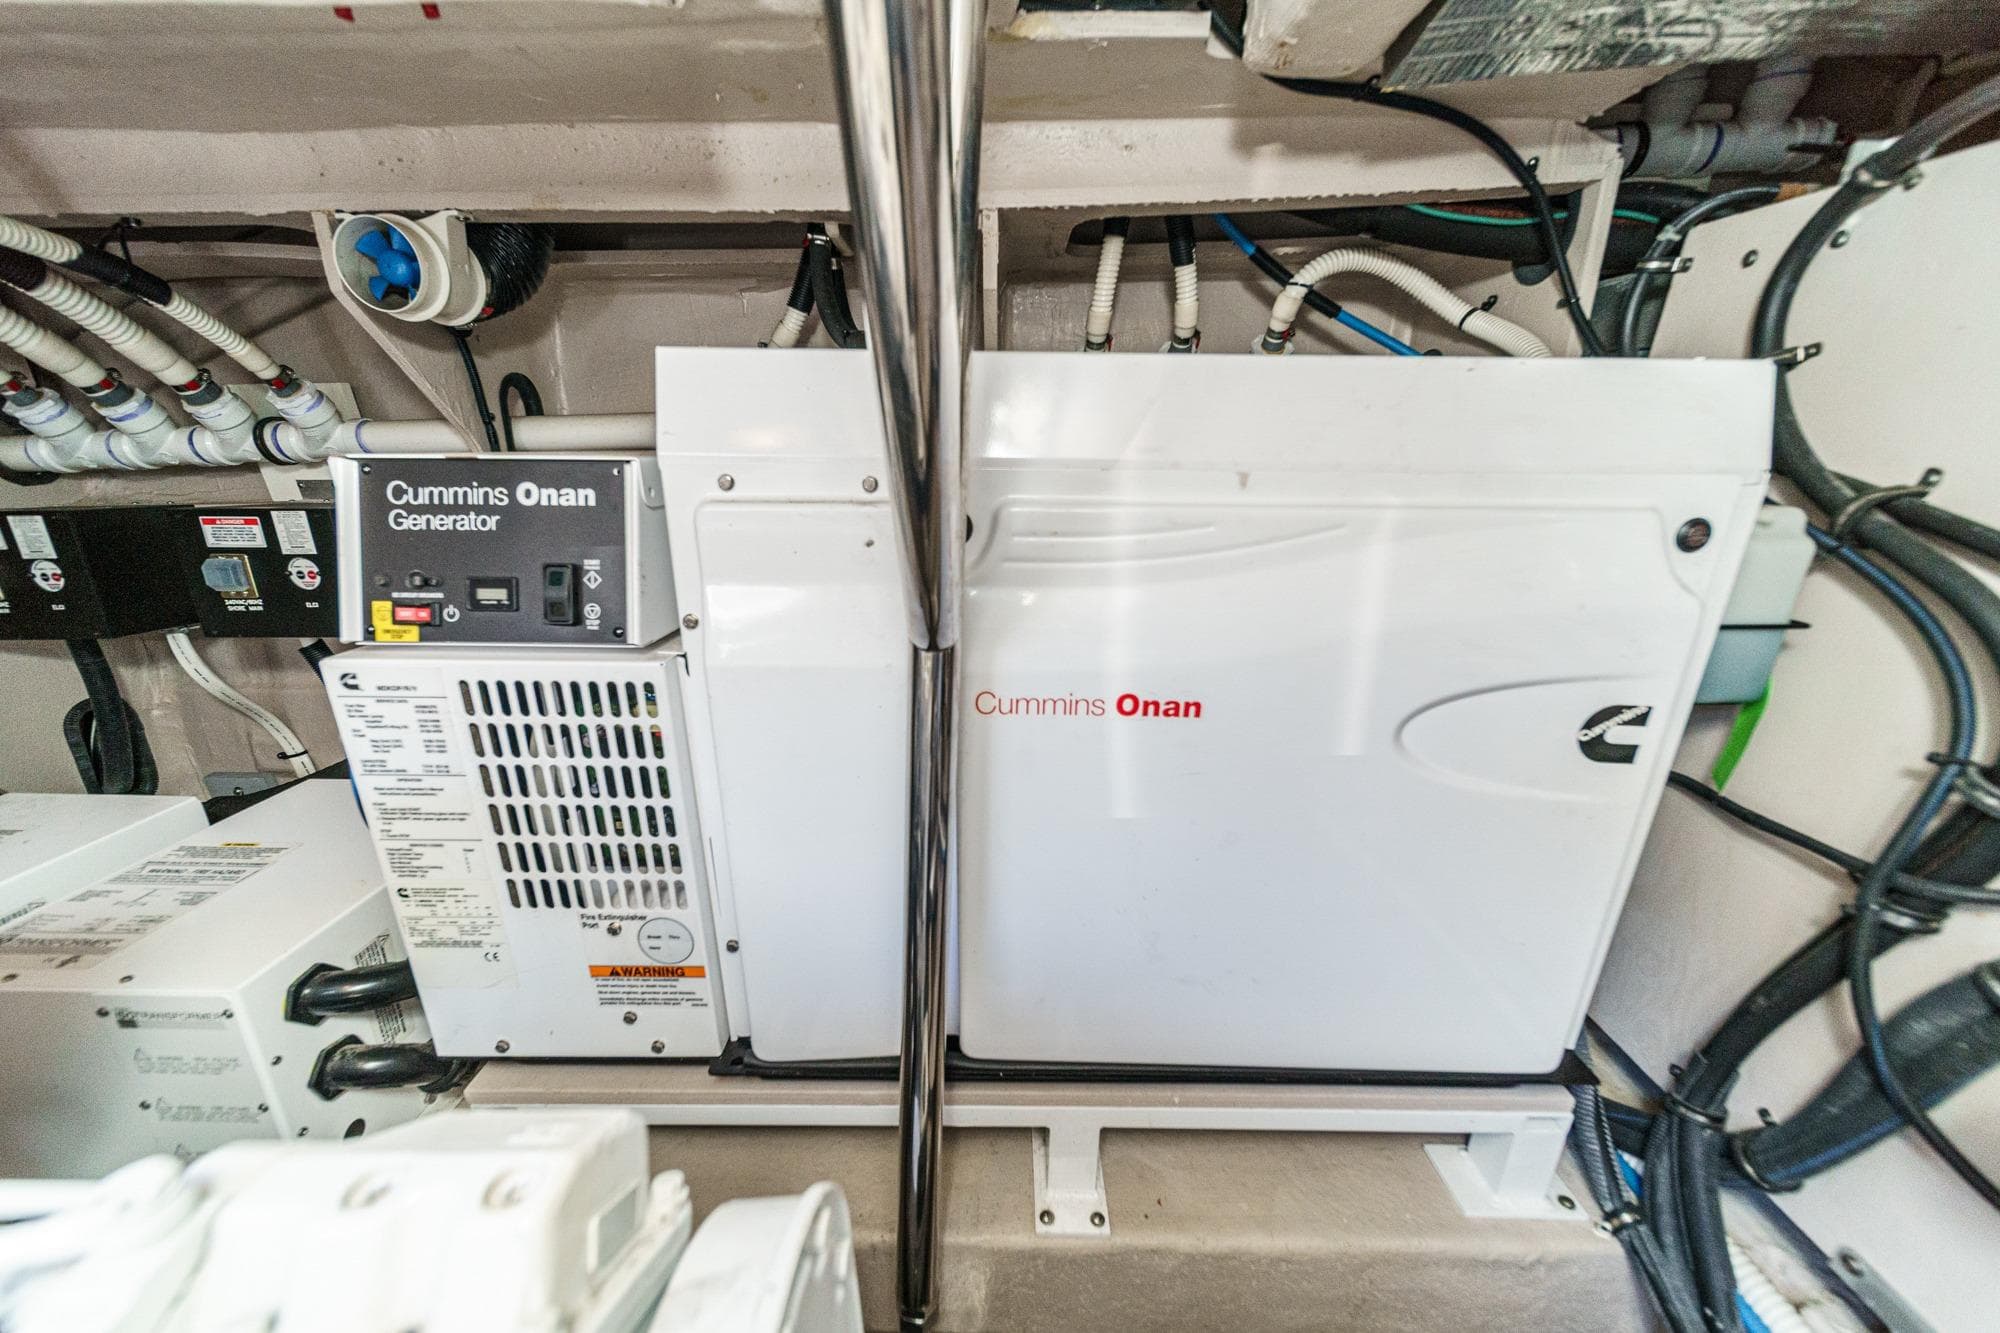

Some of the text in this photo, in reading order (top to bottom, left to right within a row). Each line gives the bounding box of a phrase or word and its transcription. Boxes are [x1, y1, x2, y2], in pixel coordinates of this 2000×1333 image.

[386, 480, 596, 507] Cummins Onan
[388, 508, 501, 531] Generator
[975, 690, 1202, 718] Cummins Onan
[621, 967, 686, 978] WARNING
